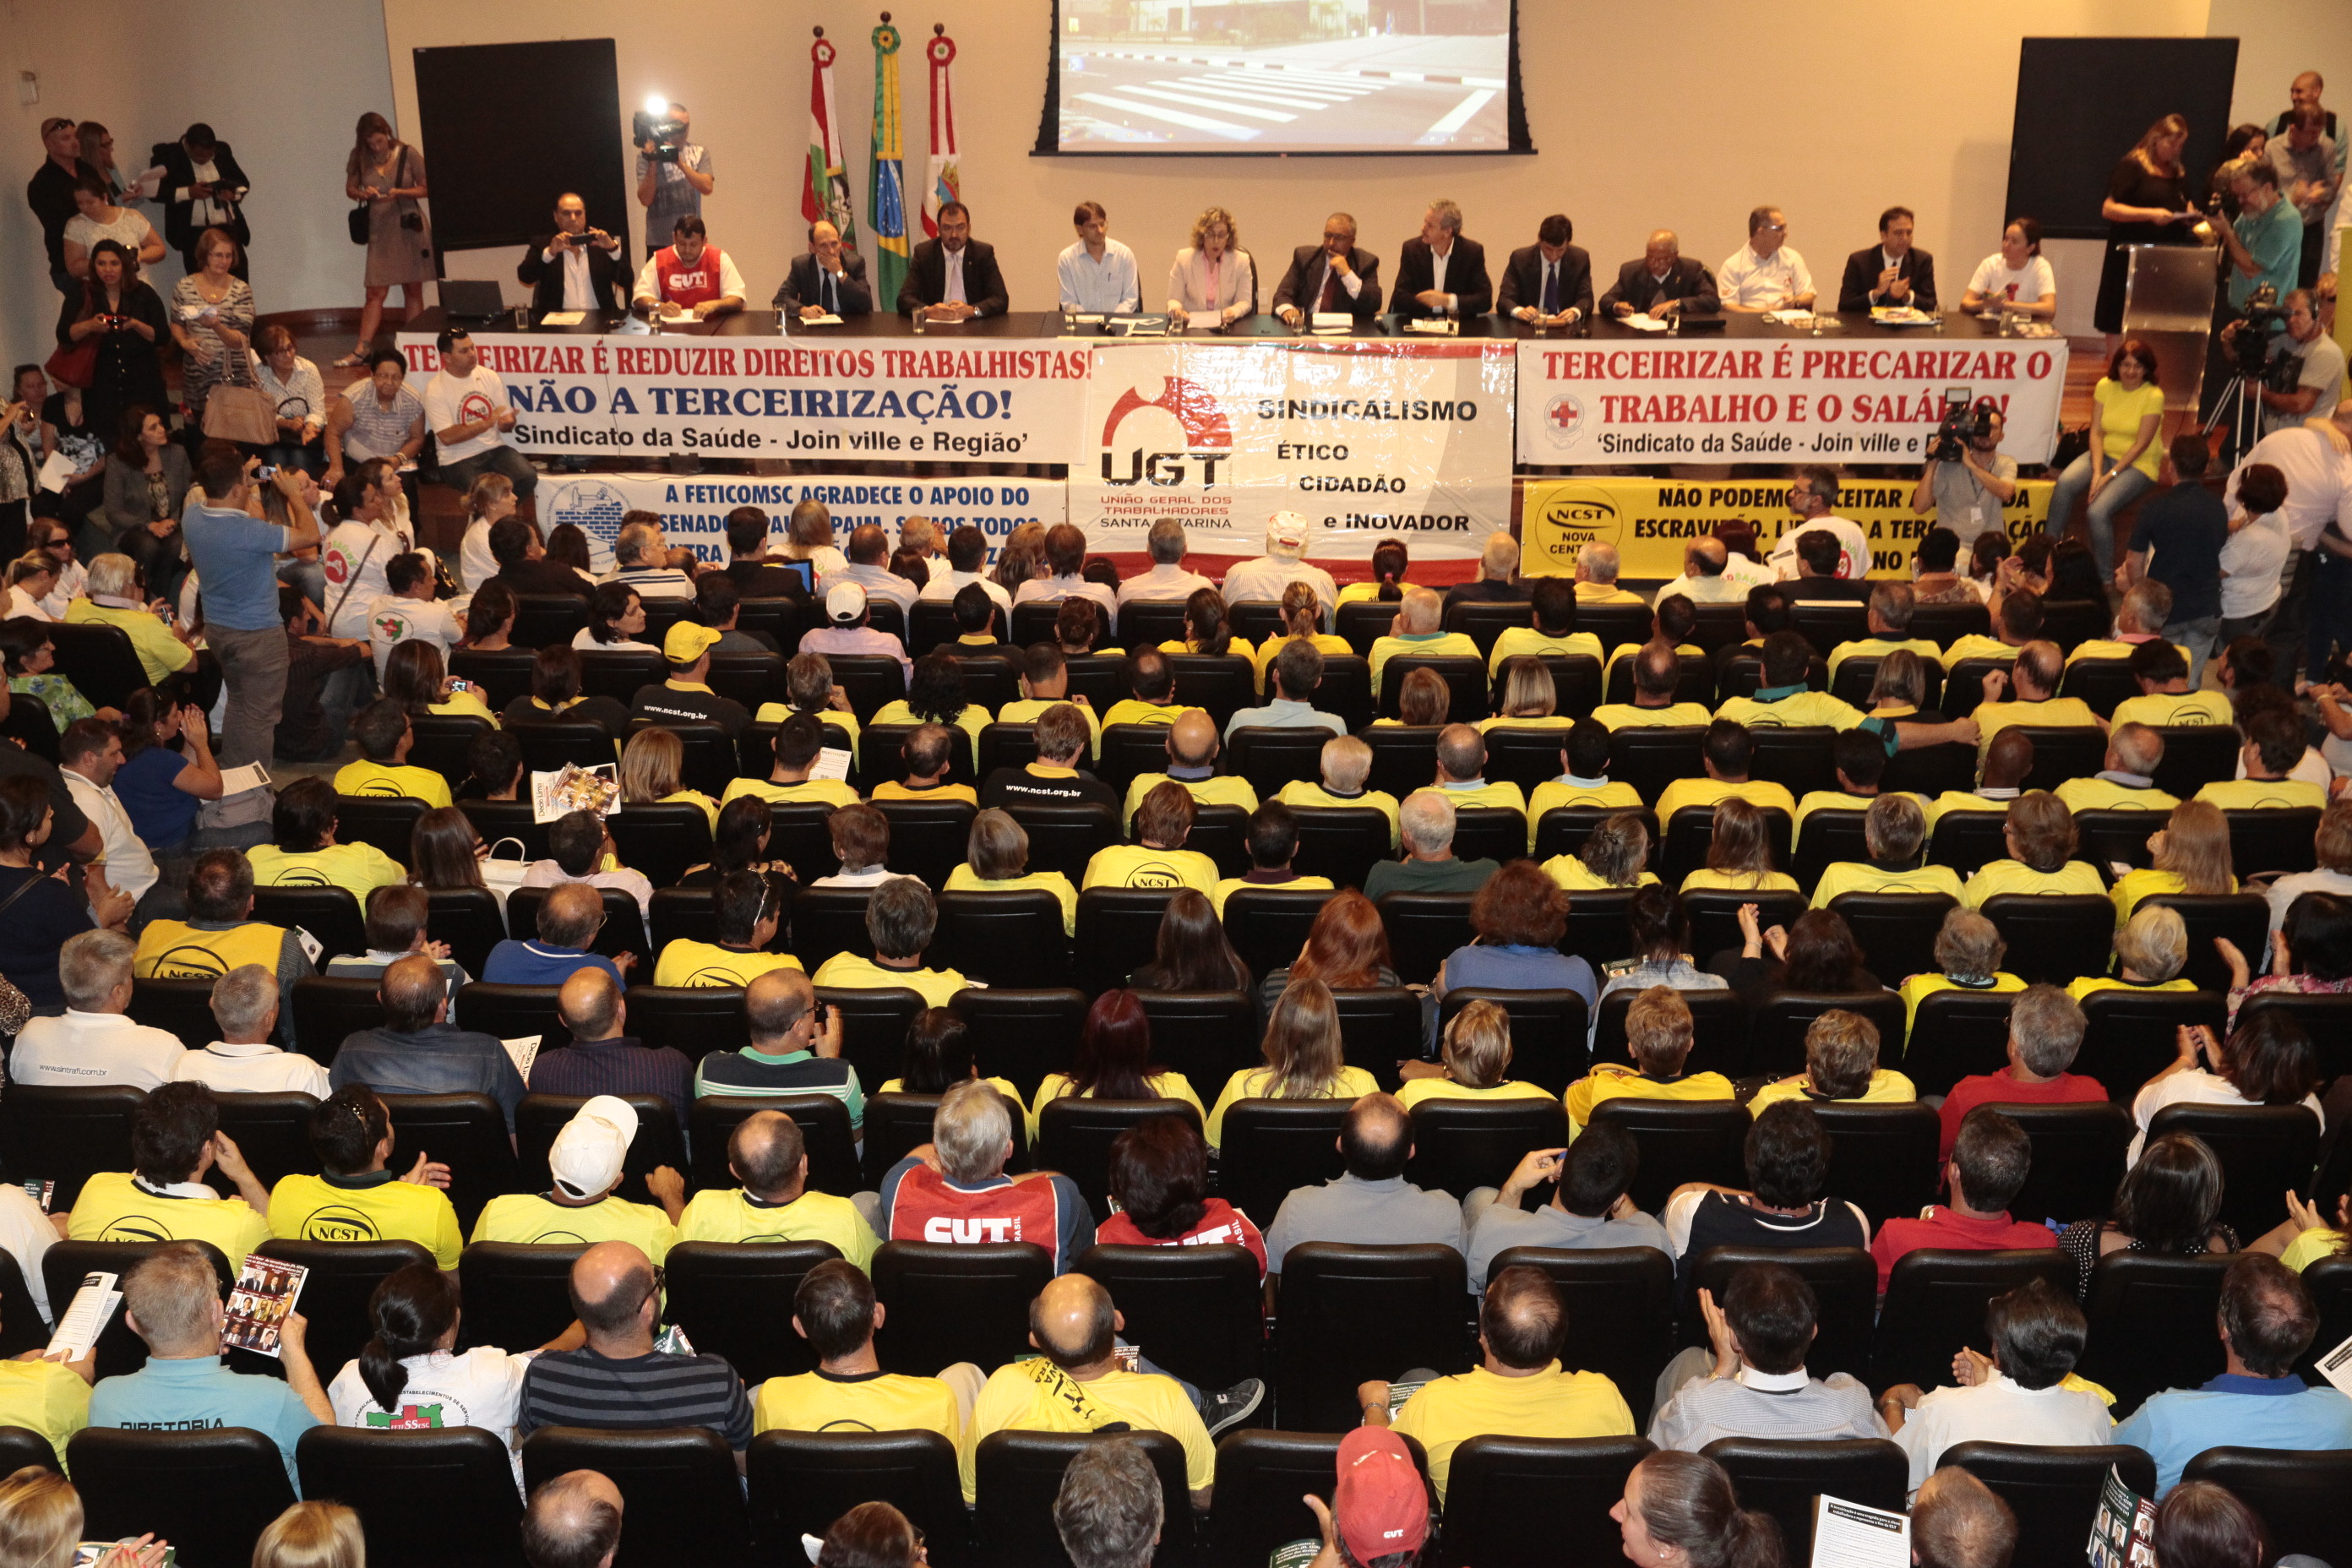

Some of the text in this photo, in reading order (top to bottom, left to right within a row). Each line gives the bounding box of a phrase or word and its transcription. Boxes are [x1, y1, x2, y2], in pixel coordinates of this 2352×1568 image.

[669, 271, 704, 288] CUT
[403, 340, 1093, 379] TEEIRIZAR É REDUZIR DIREITOS TRABALHISTAS!
[1543, 343, 2052, 380] TERCEIRIZAR É PRECARIZAR O
[507, 379, 596, 414] NÃO
[610, 387, 640, 415] A
[648, 384, 1012, 425] TERCEIRIZAÇÃO!
[1257, 400, 1478, 422] SINDICALISMO
[1599, 394, 1778, 423] TRABALHO
[1786, 395, 1808, 422] E
[1817, 395, 1843, 423] O
[1851, 388, 2010, 424] SALÁO!
[643, 428, 673, 447] da
[682, 427, 761, 449] Saúde
[787, 430, 840, 449] Join
[849, 432, 901, 450] ville
[910, 436, 924, 451] e
[1701, 434, 1725, 453] da
[1731, 431, 1793, 453] Saúde
[1811, 433, 1854, 453] Join
[1860, 433, 1901, 452] ville
[1907, 438, 1919, 452] e
[1277, 440, 1349, 460] ÉTICO
[1102, 448, 1232, 491] UGT
[1299, 474, 1406, 493] CIDADÃO
[666, 485, 1030, 506] A FETICOMSC AGRADECE O APOIO DO
[1101, 493, 1232, 504] UNIÃO GERAL DOS
[1658, 482, 1702, 507] NÃO
[1709, 487, 1791, 508] PODEM
[1833, 488, 1903, 508] CEITAR
[661, 514, 729, 533] SENAD
[1101, 518, 1233, 528] SANTA TARINA
[1324, 514, 1470, 531] e INOVADOR
[1556, 509, 1605, 520] NCST
[1562, 532, 1595, 542] NOVA
[1869, 520, 1882, 538] A
[1549, 544, 1585, 554] CENT
[1872, 552, 1903, 570] NO
[644, 705, 708, 720] www.ncst.org.br
[1005, 781, 1082, 798] www.ncst.org.br
[1140, 878, 1171, 888] NCST
[319, 1227, 362, 1241] NCST
[924, 1217, 1012, 1244] CUT
[1232, 1219, 1246, 1247] RASIL
[401, 1390, 452, 1402] STABELECIMENTOS
[1383, 1529, 1404, 1538] CUT
